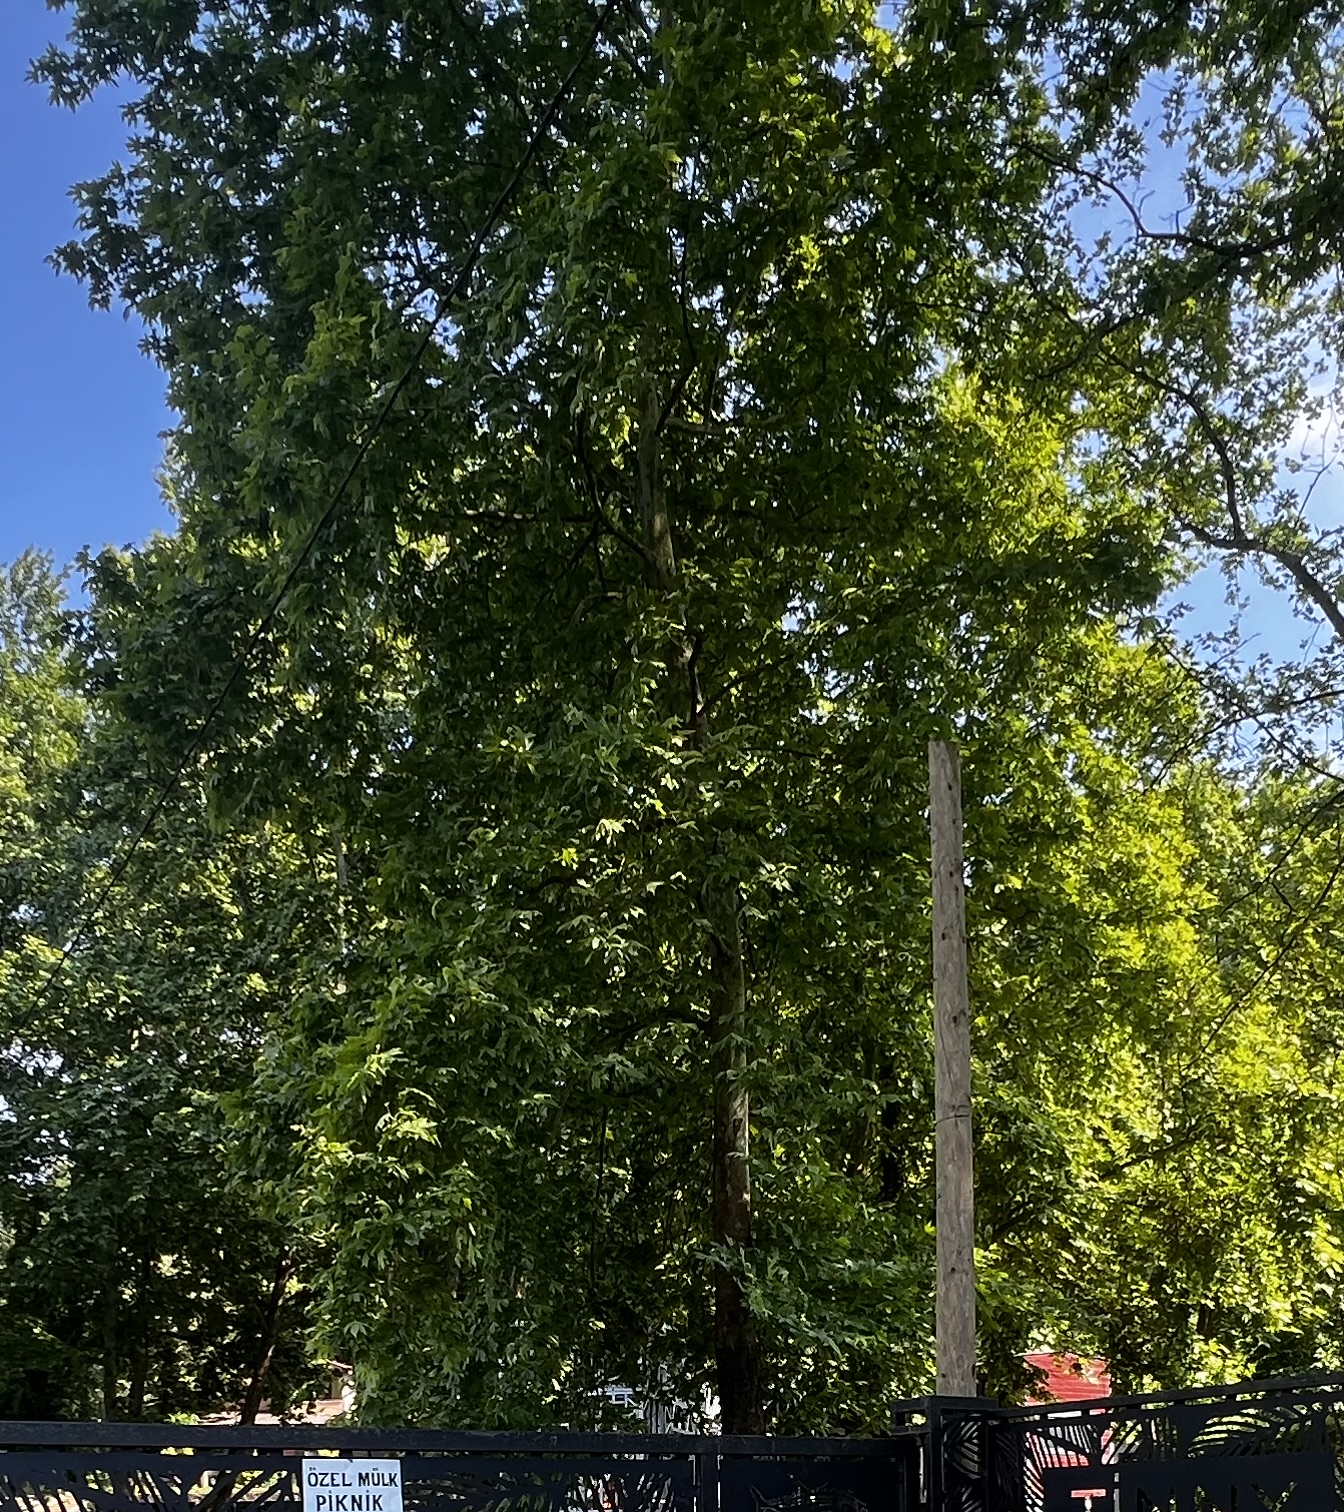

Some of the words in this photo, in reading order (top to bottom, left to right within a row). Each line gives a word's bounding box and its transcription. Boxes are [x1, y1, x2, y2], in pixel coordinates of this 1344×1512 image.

[307, 1467, 353, 1487] ÖZEL
[358, 1467, 399, 1487] MÜLK
[315, 1490, 384, 1512] PİKNİK
